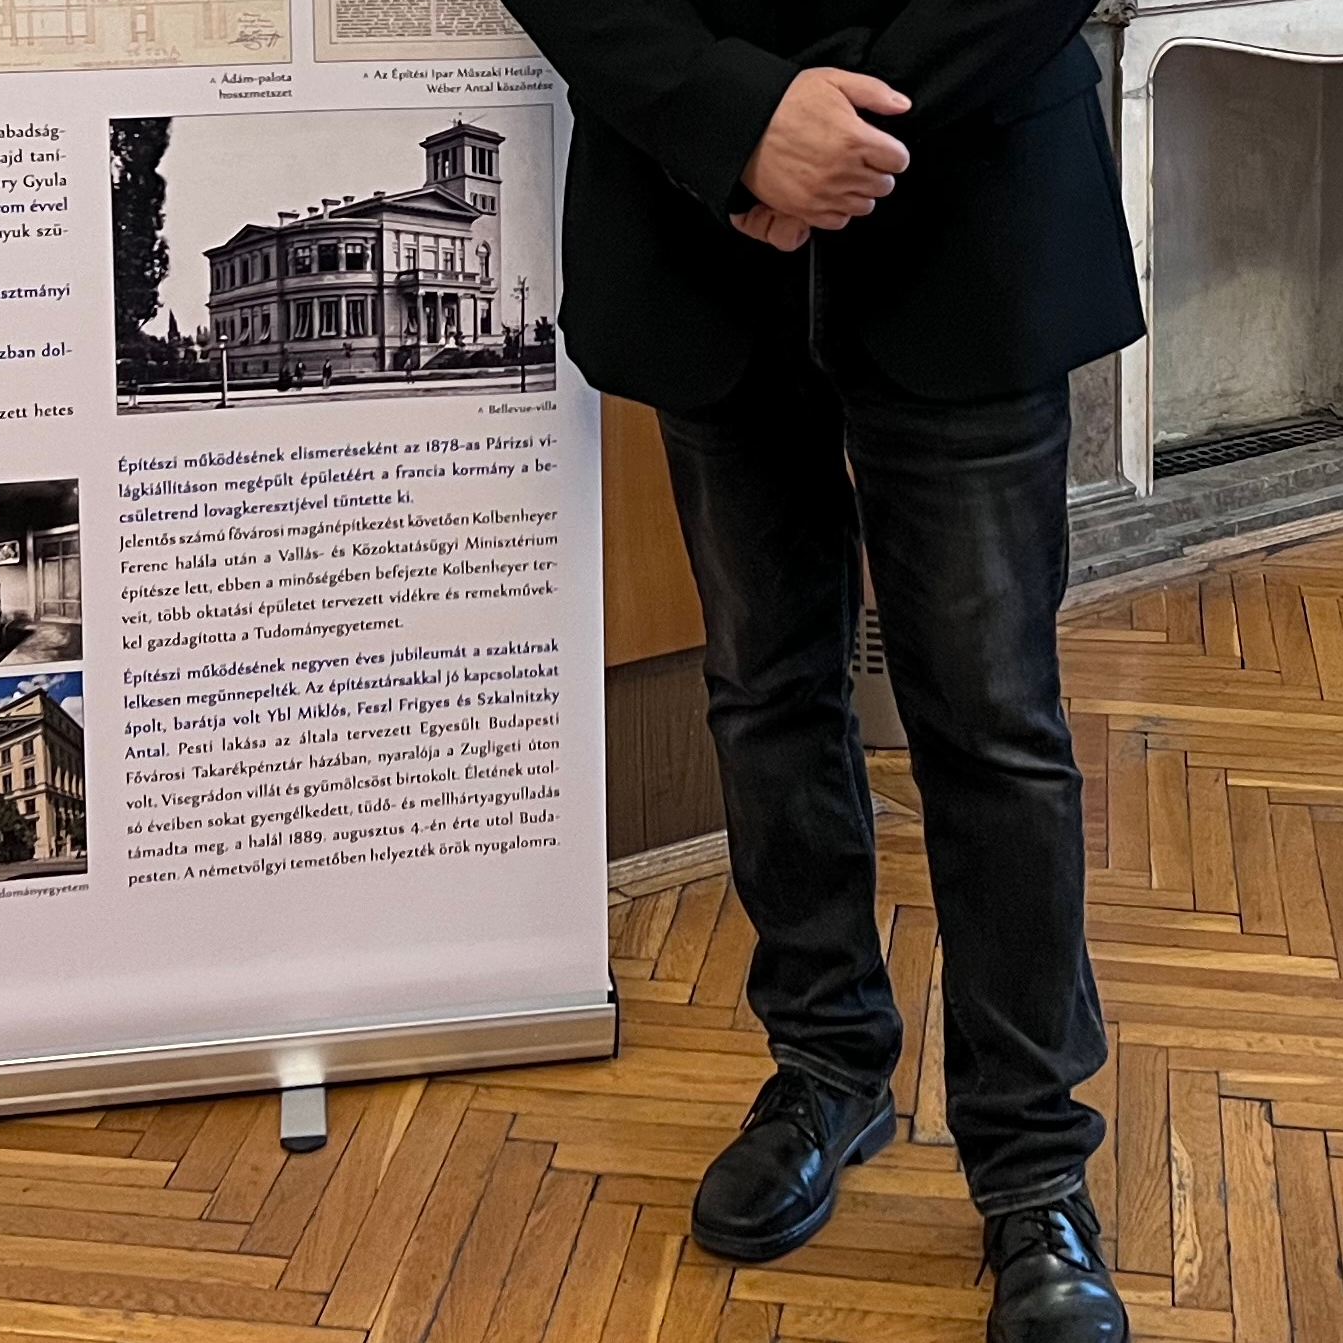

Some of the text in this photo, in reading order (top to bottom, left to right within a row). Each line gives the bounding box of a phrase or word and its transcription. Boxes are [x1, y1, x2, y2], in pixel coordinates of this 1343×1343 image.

[127, 834, 560, 888] pesten. A németvölgyi temetőben helyezték örök nyugalomra.
